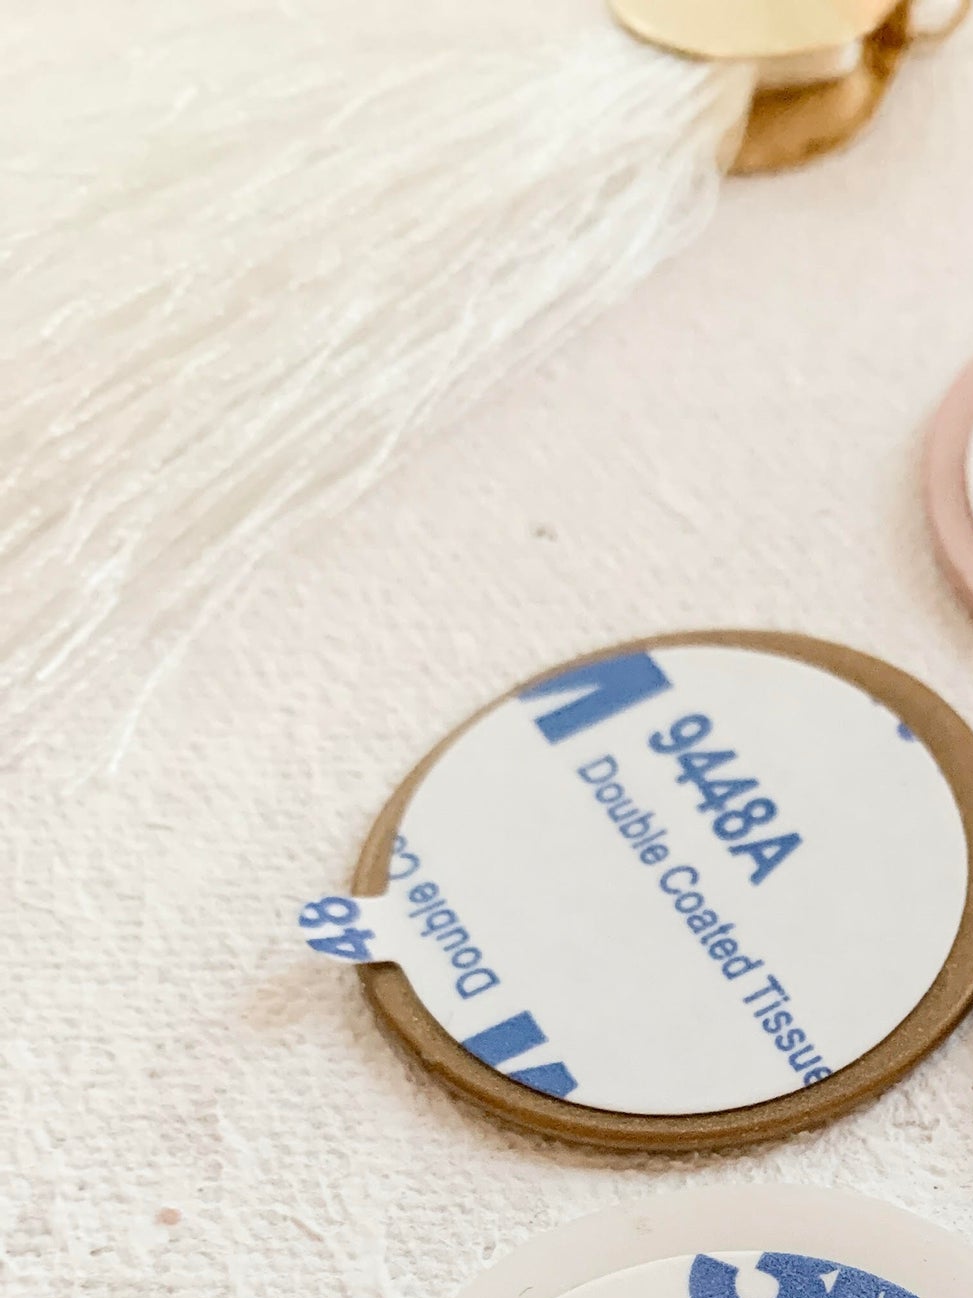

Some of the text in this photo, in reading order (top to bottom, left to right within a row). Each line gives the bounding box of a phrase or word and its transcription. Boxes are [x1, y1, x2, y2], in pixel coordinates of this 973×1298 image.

[647, 712, 803, 886] 9448A
[404, 880, 501, 1001] Double
[577, 754, 669, 865] Double
[659, 865, 764, 981] Coated
[742, 974, 834, 1085] Tissue
